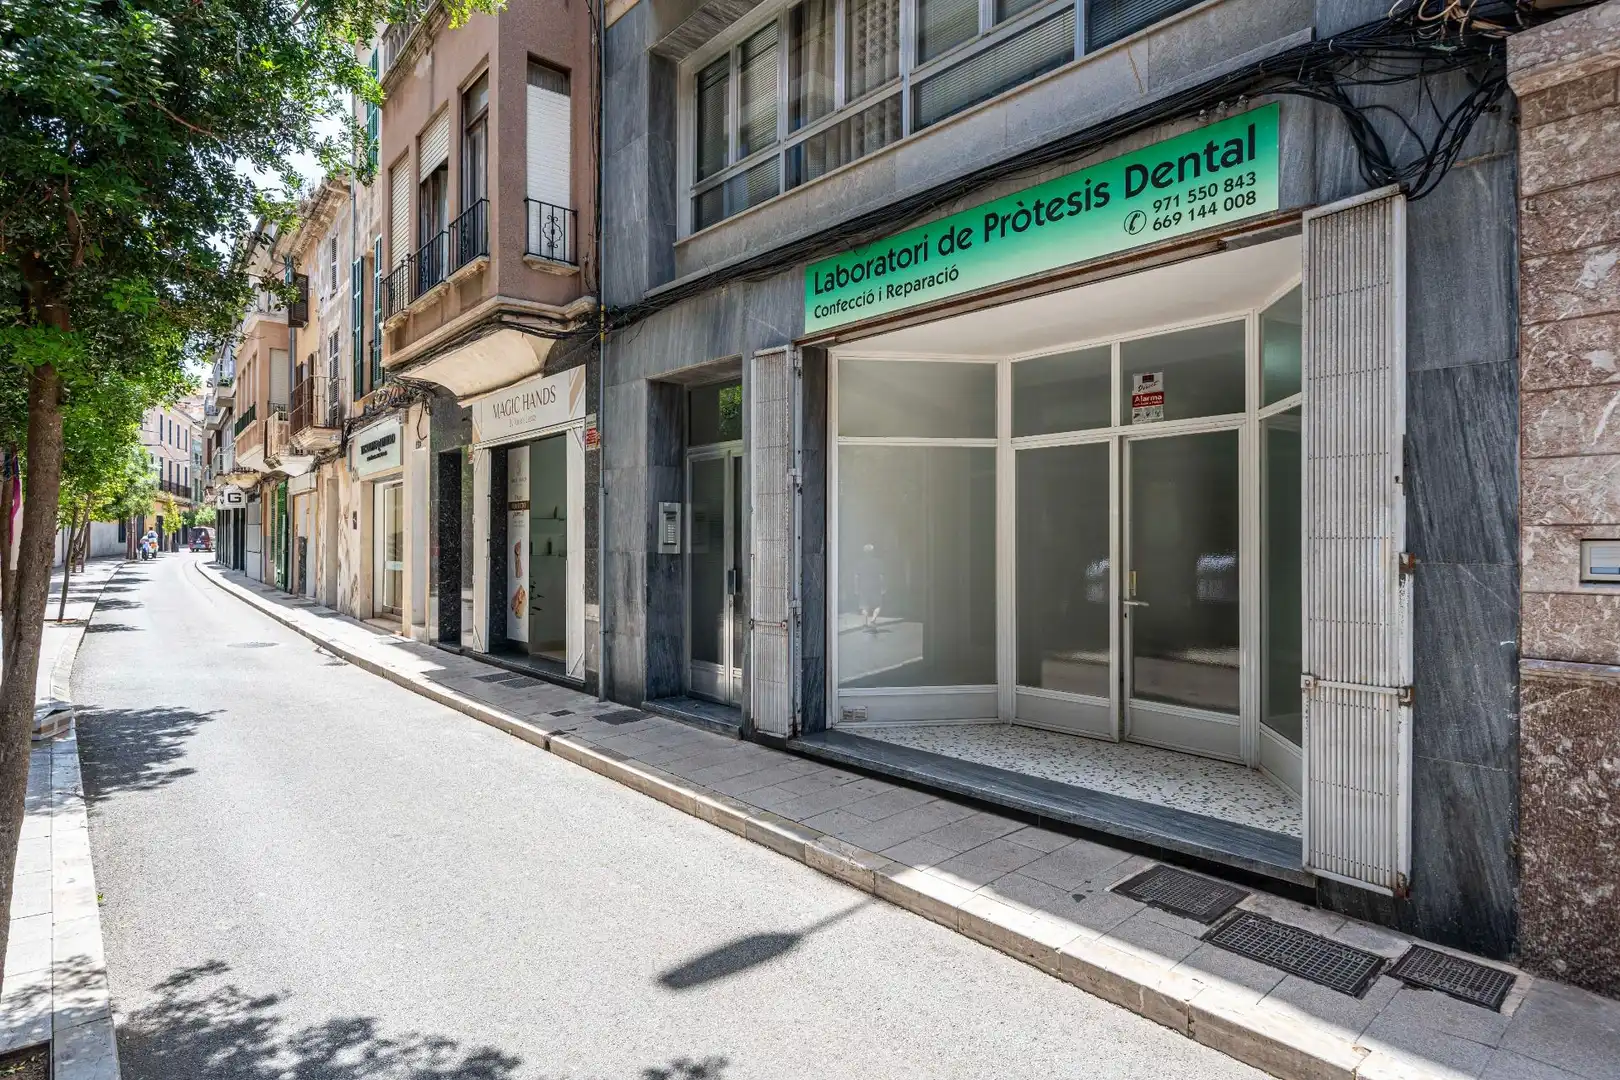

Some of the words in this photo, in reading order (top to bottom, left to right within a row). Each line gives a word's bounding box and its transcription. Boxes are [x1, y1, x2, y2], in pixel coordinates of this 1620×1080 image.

[814, 234, 928, 295] Laboratori
[937, 225, 973, 256] de
[984, 178, 1110, 243] Pròtesis
[1125, 123, 1255, 200] Dental
[1153, 193, 1180, 213] 971
[1187, 183, 1218, 204] 550
[1223, 171, 1256, 192] 843
[1153, 211, 1182, 231] 669
[1188, 202, 1218, 221] 144
[1223, 190, 1256, 212] 008
[814, 289, 874, 319] Confecció
[878, 287, 882, 303] i
[886, 264, 959, 299] Reparació
[492, 396, 520, 419] MAGIC
[522, 384, 556, 411] HANDS
[1134, 394, 1163, 402] Alarma
